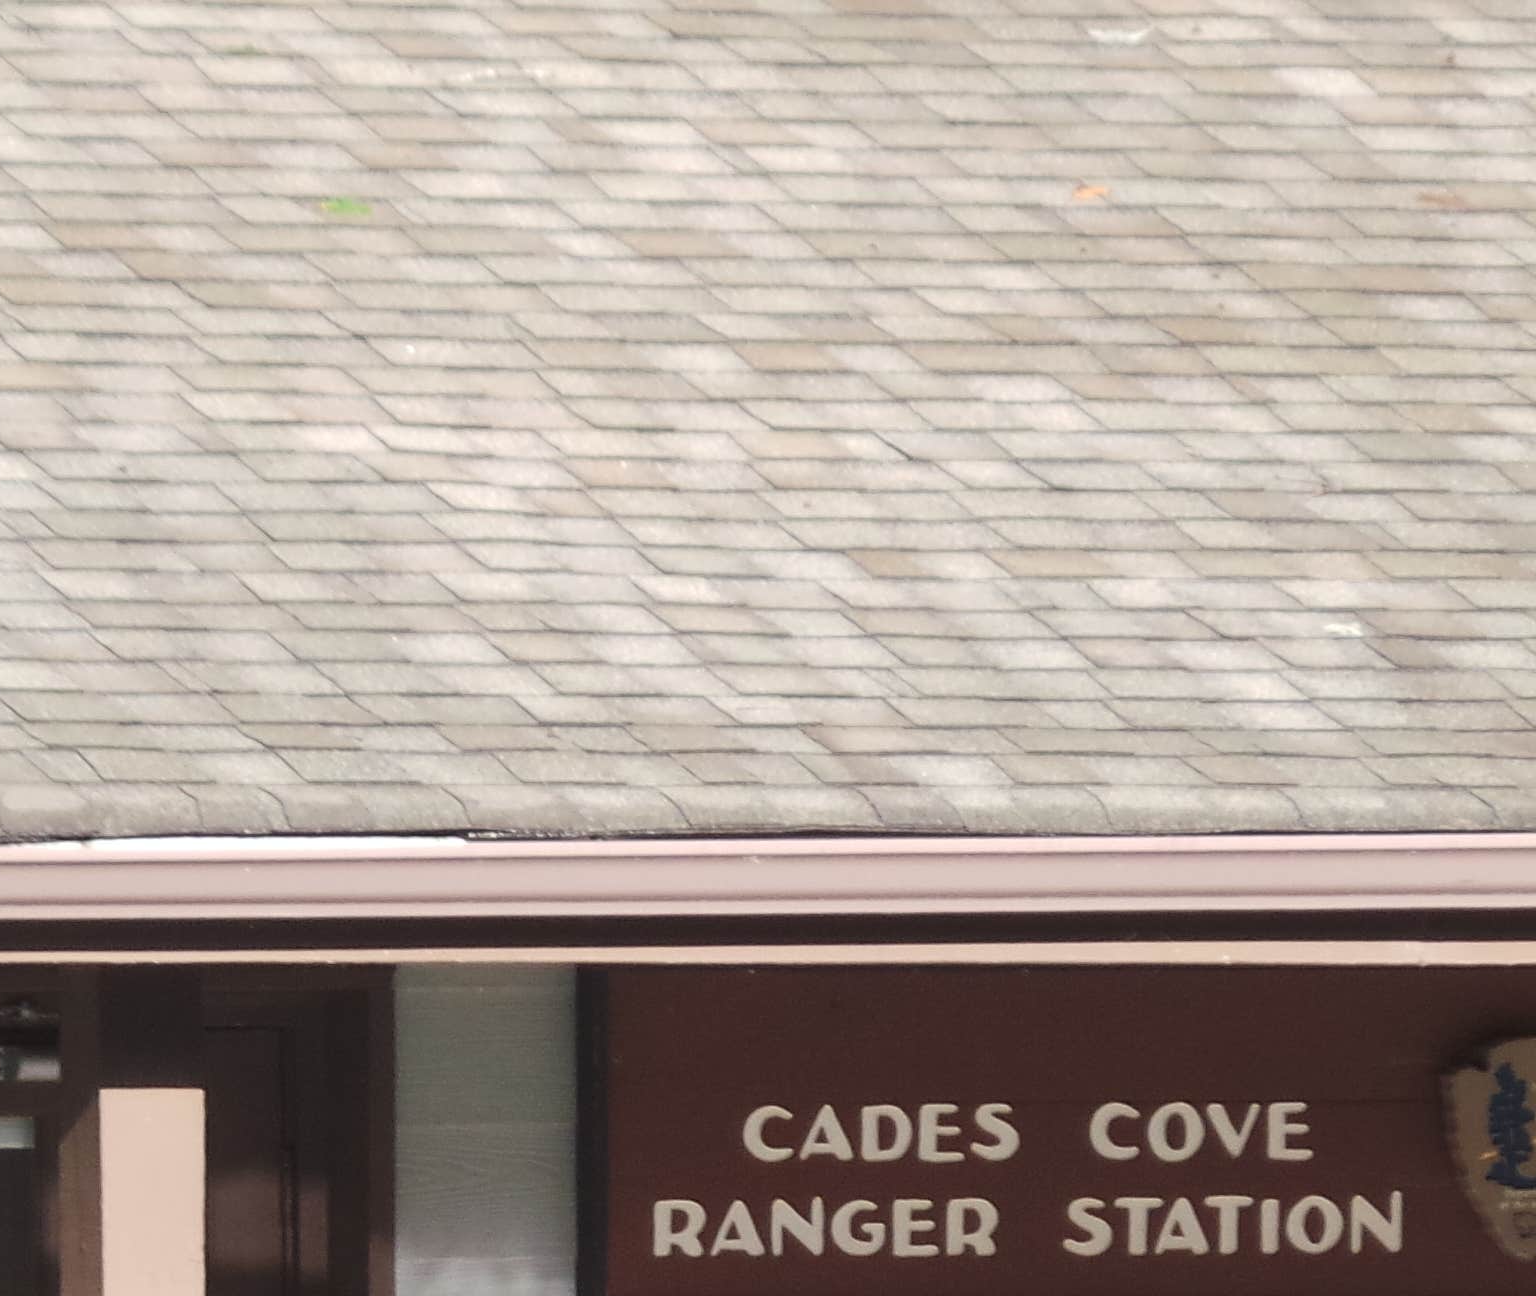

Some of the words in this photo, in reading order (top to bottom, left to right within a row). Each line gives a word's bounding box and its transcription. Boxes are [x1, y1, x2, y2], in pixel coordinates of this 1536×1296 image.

[742, 1102, 1020, 1163] CADES
[1087, 1101, 1314, 1163] COVE
[651, 1195, 1000, 1259] RANGER
[1062, 1192, 1403, 1255] STATION
